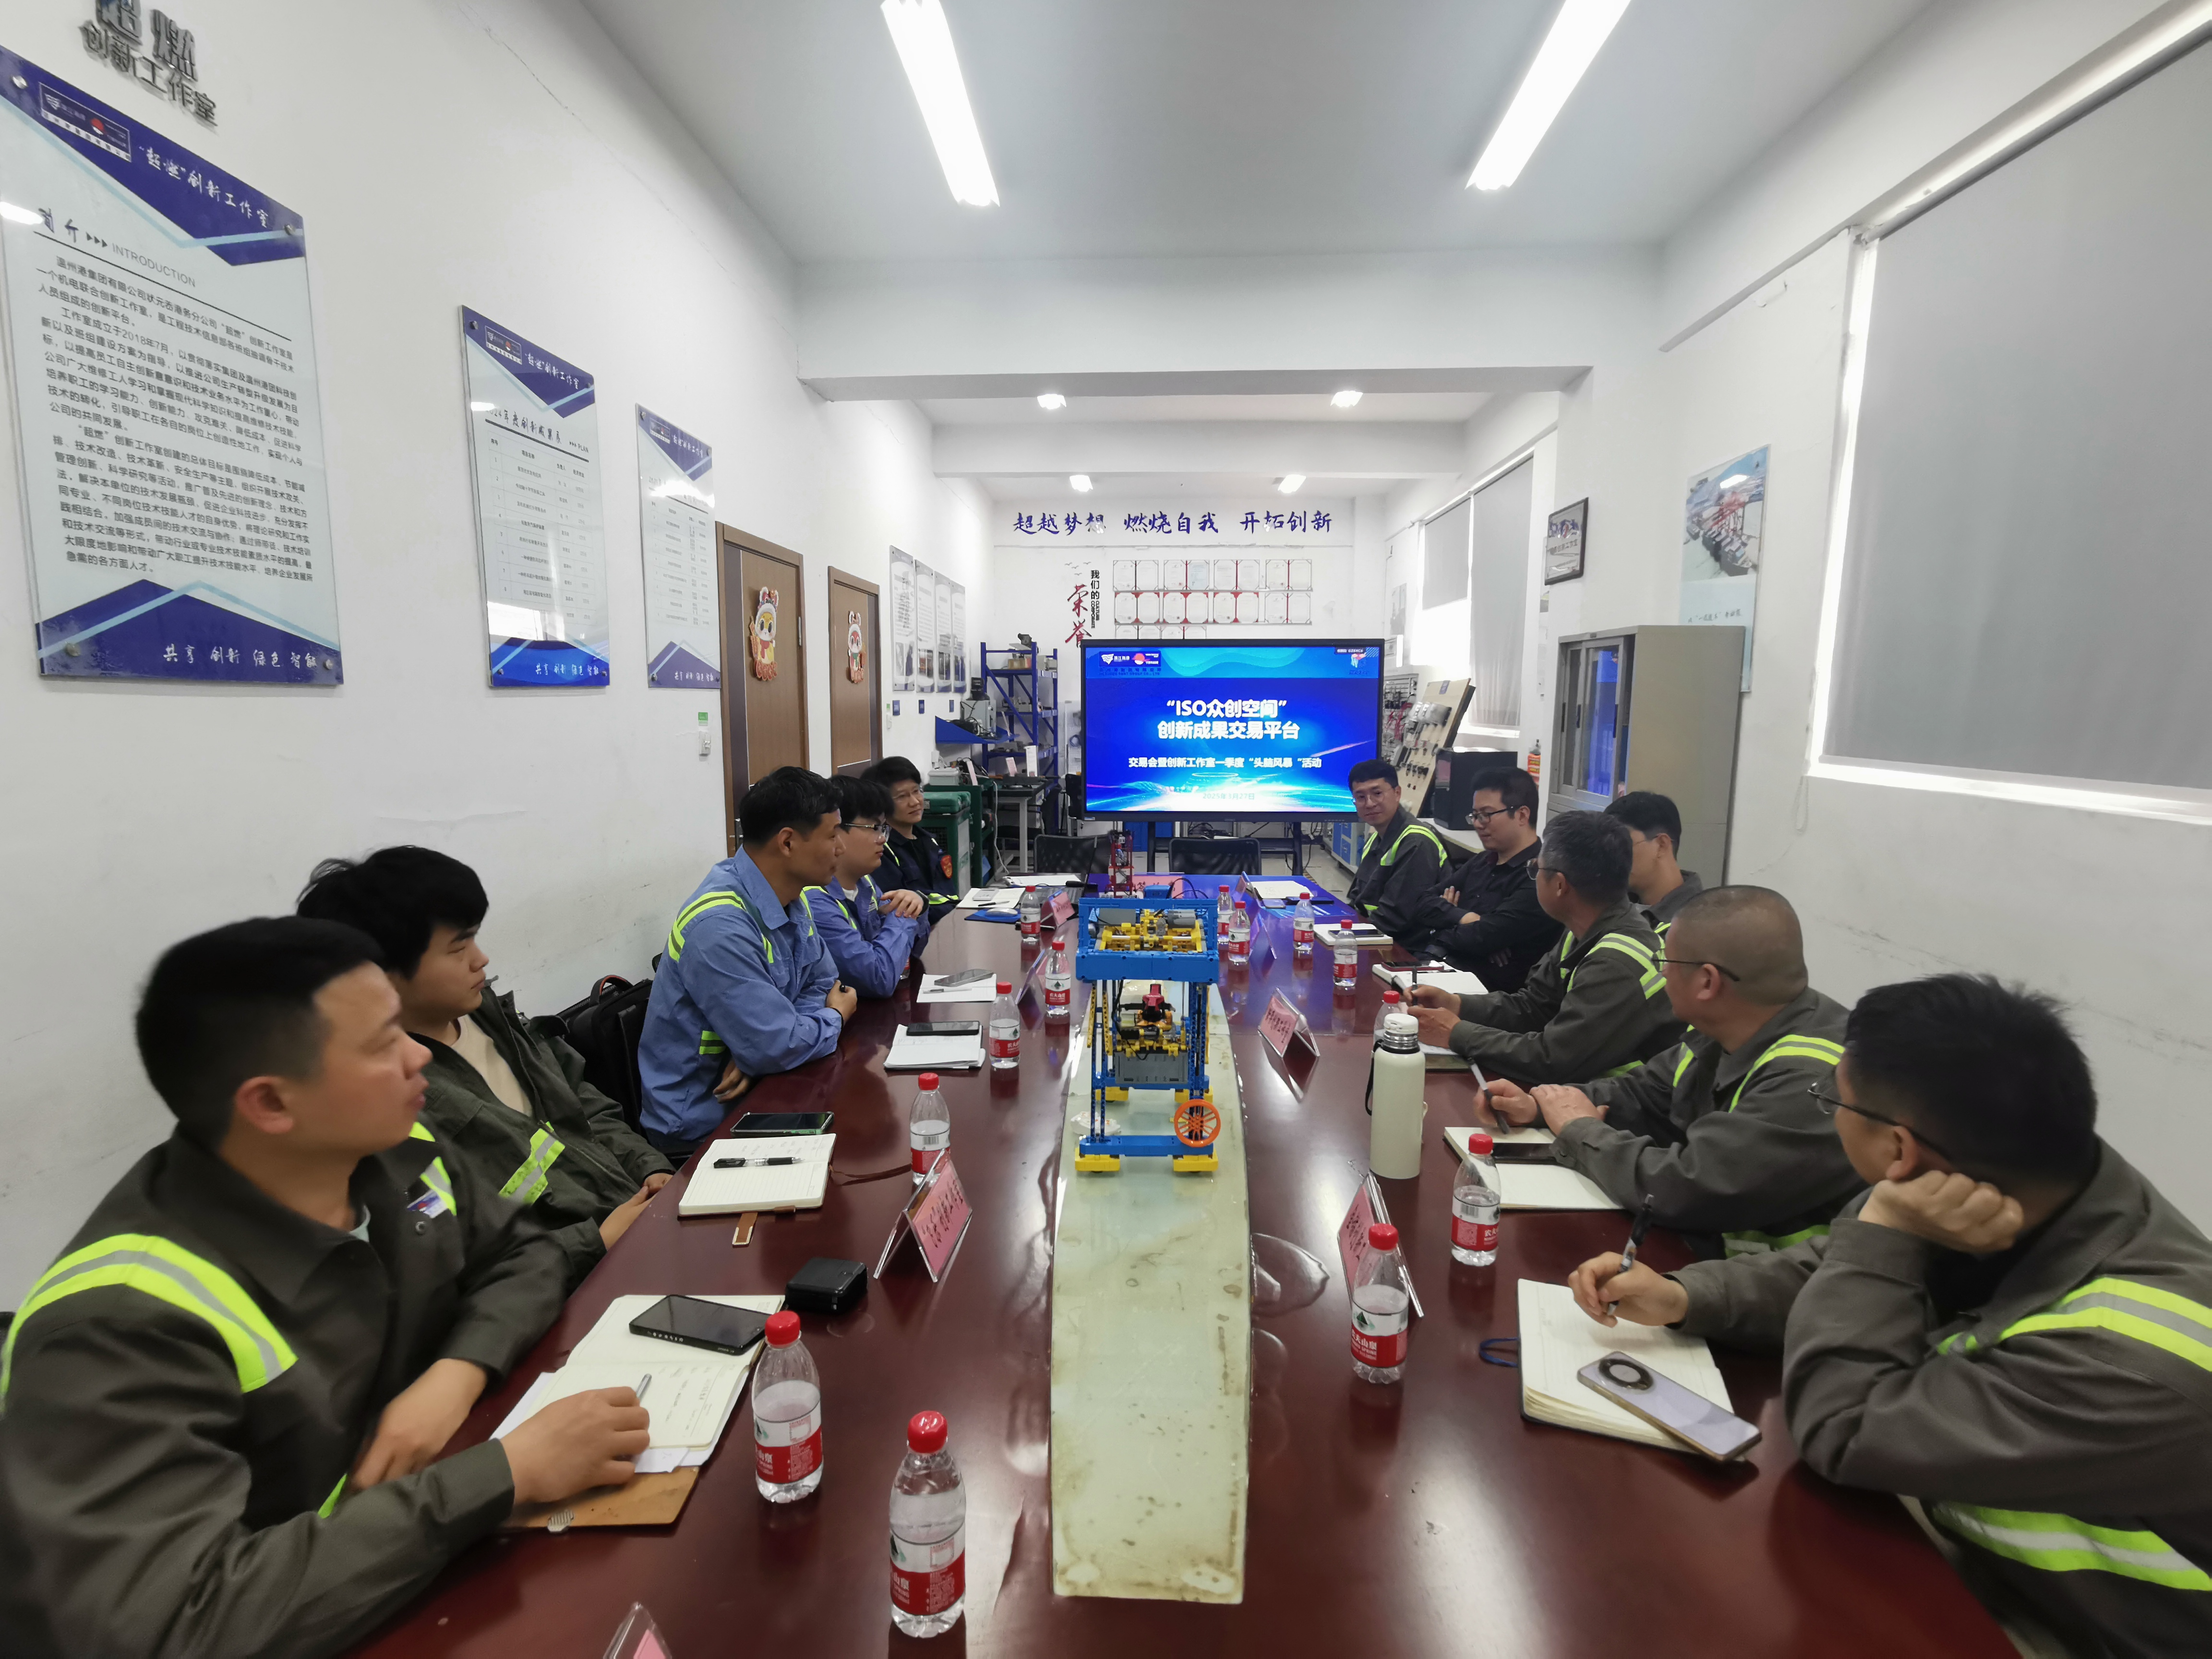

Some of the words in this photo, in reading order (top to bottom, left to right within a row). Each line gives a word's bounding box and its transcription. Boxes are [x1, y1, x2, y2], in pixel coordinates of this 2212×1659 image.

[78, 22, 217, 126] 创新工作室
[112, 243, 196, 288] INTRODUCTION
[38, 284, 134, 326] 人员组成的创新平台。
[49, 402, 127, 430] 公司的共同发展。
[486, 409, 562, 445] 024年度创新成果展
[1013, 512, 1106, 536] 超越梦想
[1124, 511, 1218, 533] 燃烧自我
[1239, 510, 1332, 534] 开拓创新
[1091, 570, 1100, 600] 我们的
[210, 646, 240, 664] 创新
[1166, 699, 1287, 718] “ISO众创空间”
[1157, 721, 1300, 739] 创新成果交易平台
